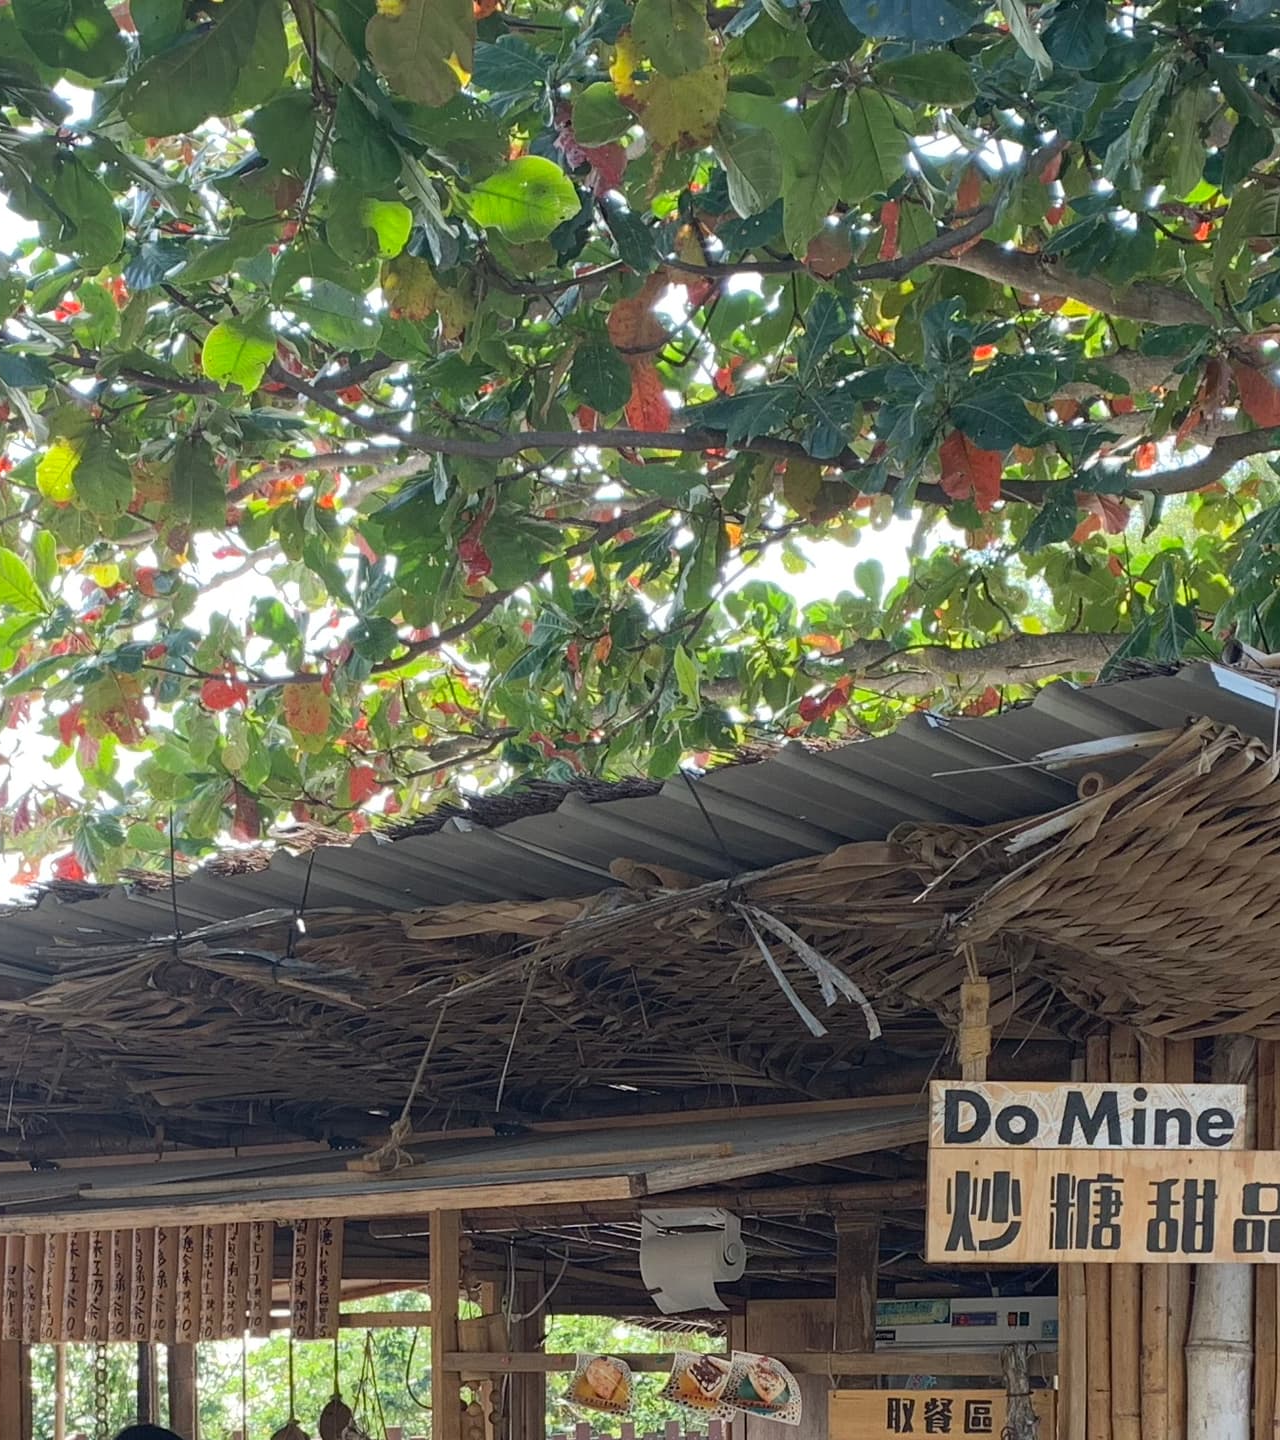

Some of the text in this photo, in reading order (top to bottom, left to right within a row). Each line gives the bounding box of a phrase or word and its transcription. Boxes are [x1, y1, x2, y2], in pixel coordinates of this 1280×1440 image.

[944, 1087, 1235, 1147] Do Mine
[886, 1397, 993, 1434] 取餐區
